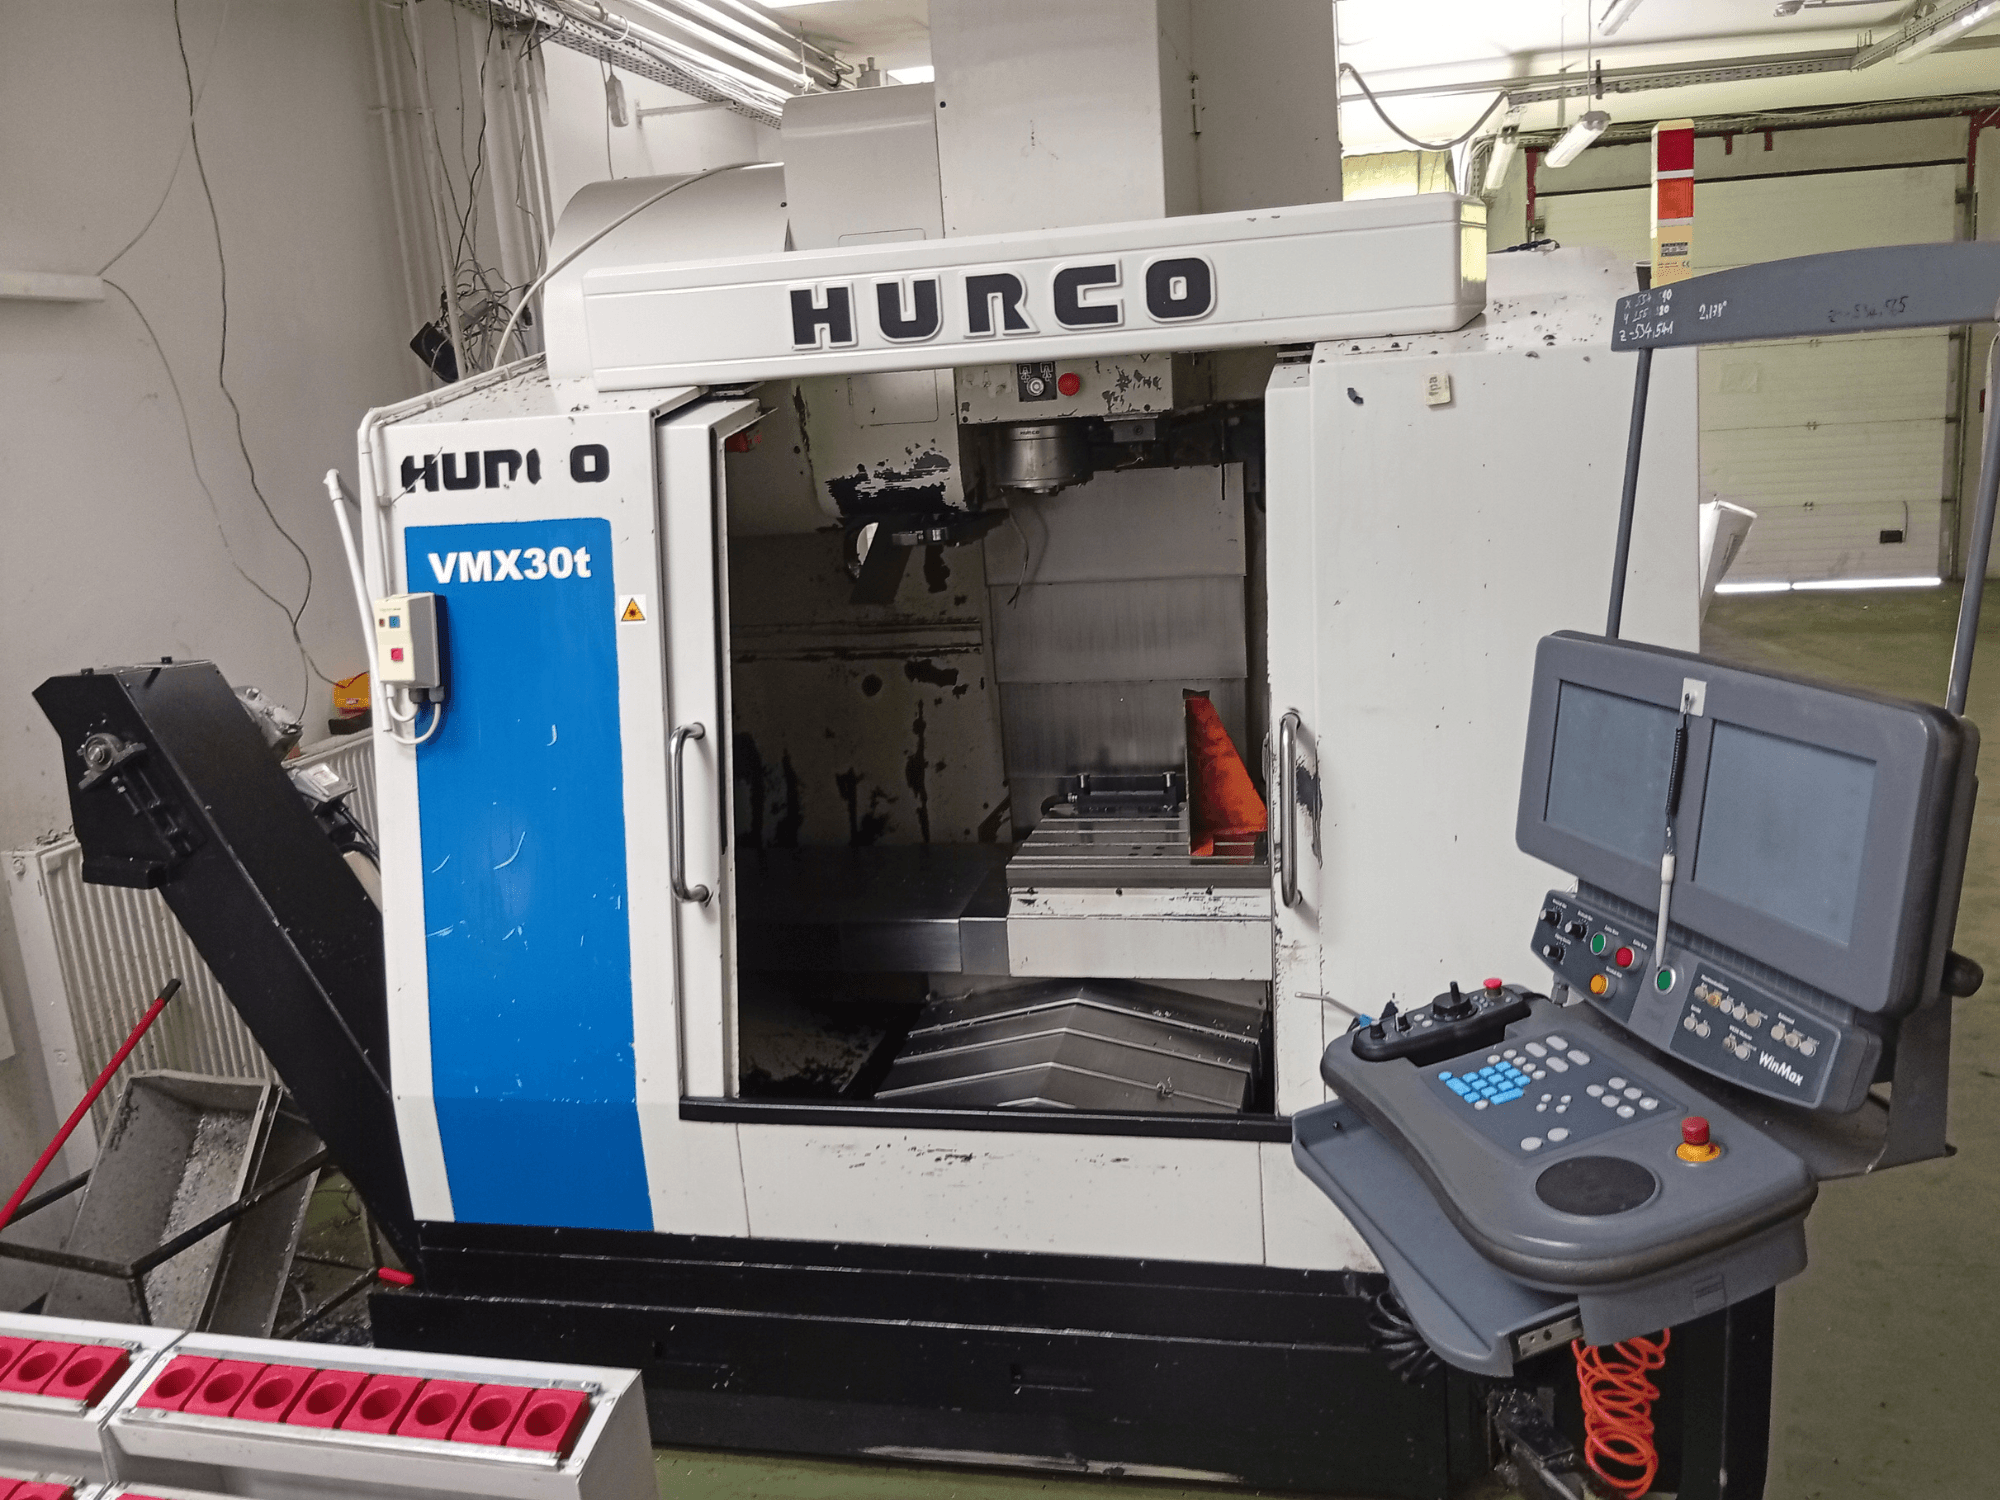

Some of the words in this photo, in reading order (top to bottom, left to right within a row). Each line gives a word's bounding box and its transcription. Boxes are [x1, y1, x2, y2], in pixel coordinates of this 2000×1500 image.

[788, 256, 1213, 347] HURCO
[427, 546, 592, 584] VMX30t
[1758, 1050, 1804, 1087] WinMax
